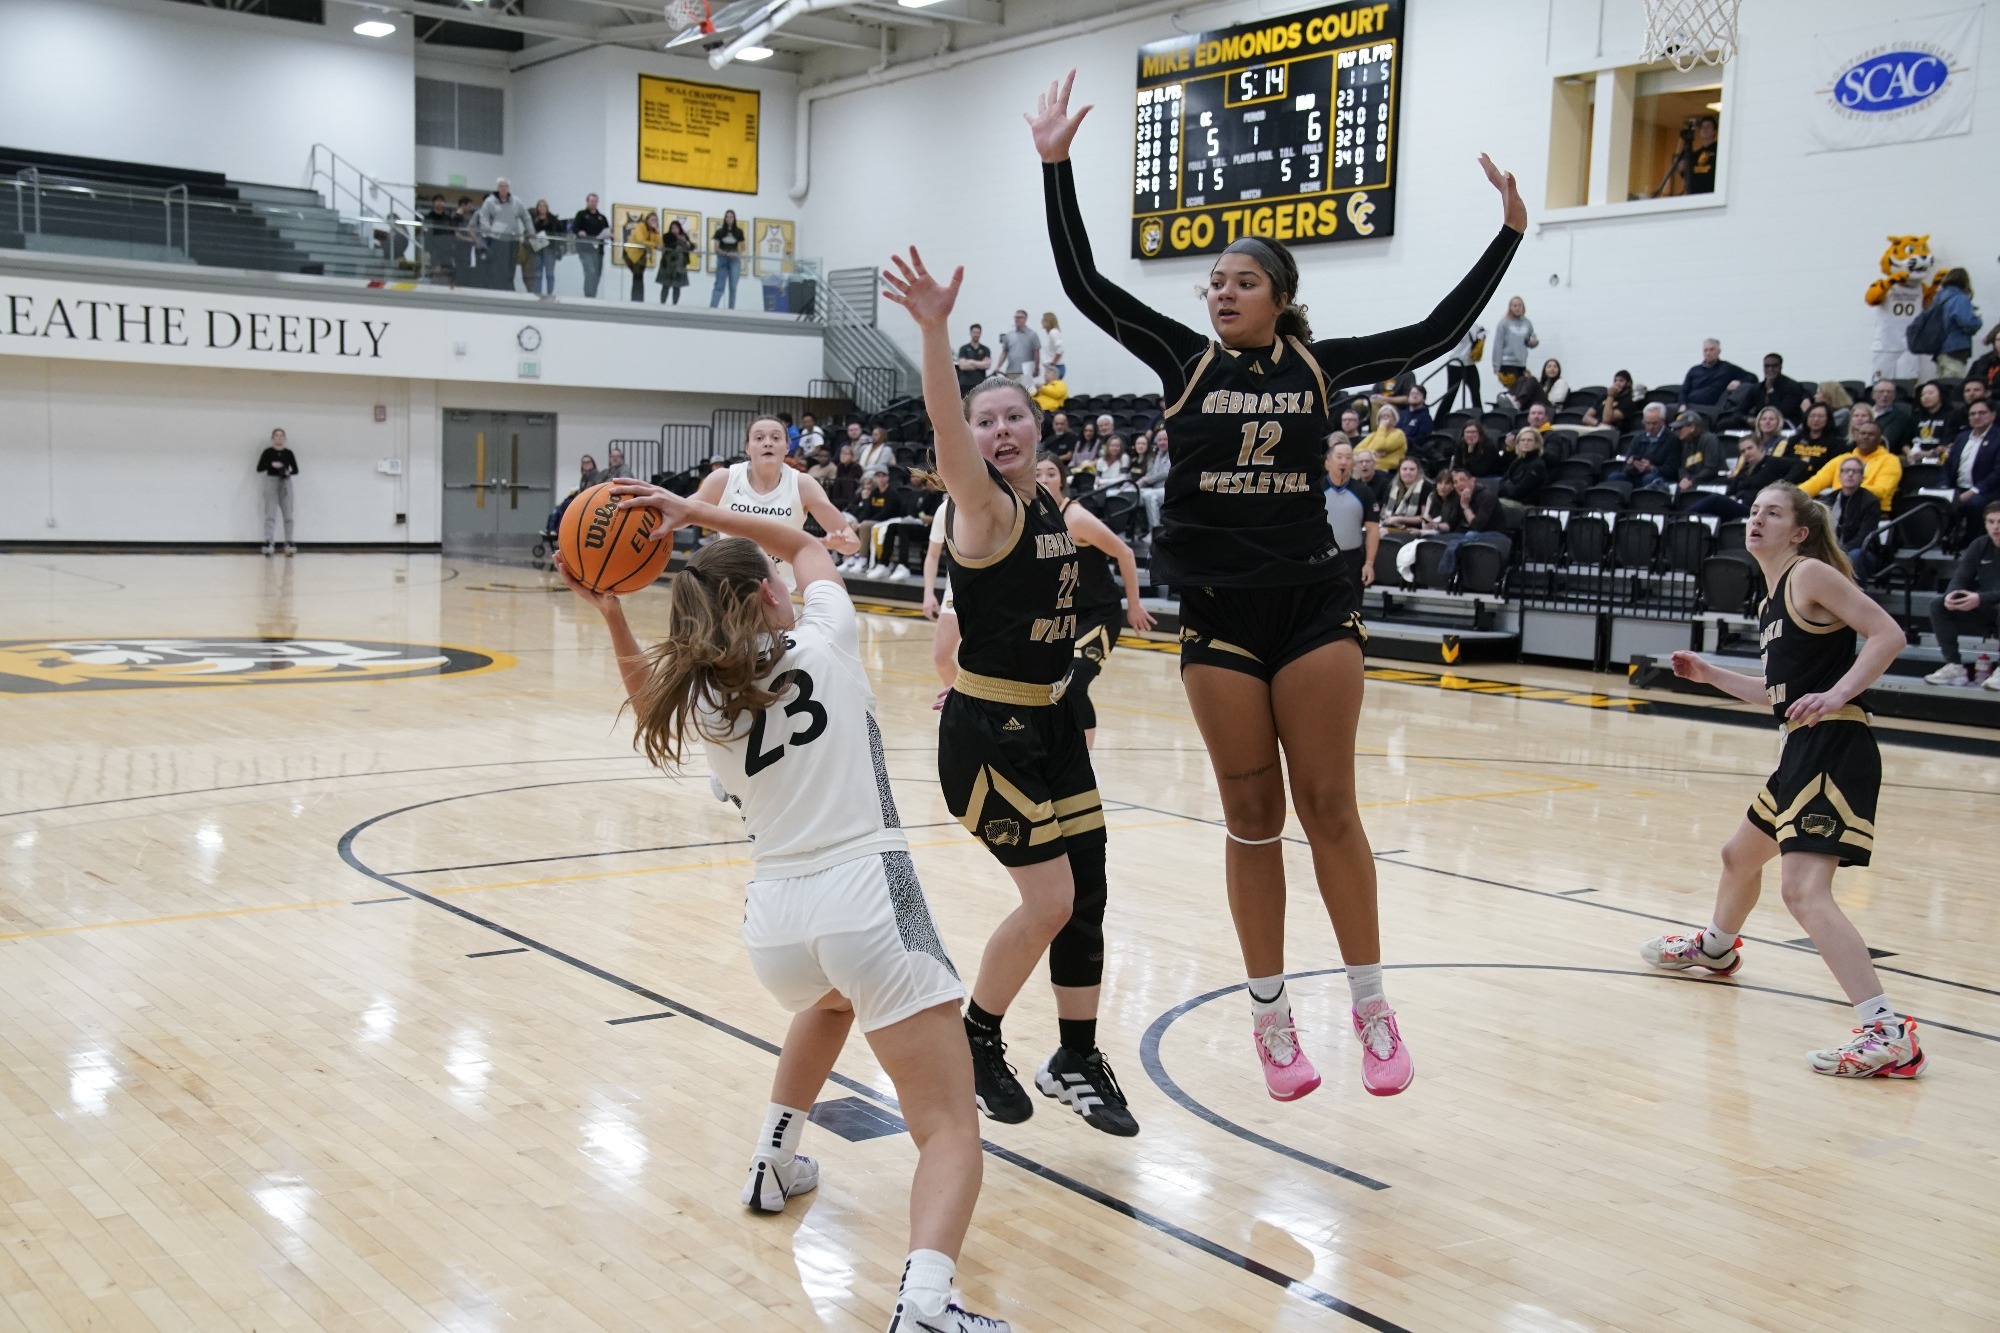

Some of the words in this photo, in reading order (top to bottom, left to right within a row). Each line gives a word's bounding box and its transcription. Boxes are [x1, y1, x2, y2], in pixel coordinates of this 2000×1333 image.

[1142, 51, 1190, 78] MIKE
[1194, 23, 1302, 67] EDMONDS
[1306, 4, 1389, 45] COURT
[1241, 67, 1284, 101] 5:14
[1841, 56, 1937, 106] SCAC
[1337, 88, 1355, 108] 23
[1138, 105, 1152, 123] 22
[1336, 109, 1354, 128] 24
[1137, 123, 1152, 141] 23
[1253, 125, 1259, 145] 1
[1307, 111, 1321, 141] 6
[1207, 127, 1220, 156] 5
[1301, 142, 1323, 156] FOULS
[1336, 128, 1353, 148] 32
[1136, 159, 1151, 177] 32
[1281, 158, 1292, 181] 5
[1308, 154, 1320, 178] 3
[1335, 149, 1352, 168] 34
[1135, 178, 1150, 194] 34
[1169, 173, 1178, 190] 3
[1213, 167, 1224, 191] 5
[1355, 166, 1364, 185] 3
[1300, 181, 1322, 194] SCORE
[1170, 213, 1215, 251] GO
[1221, 199, 1338, 245] TIGERS
[1893, 303, 1915, 316] 00
[0, 295, 189, 347] EATHE
[204, 309, 391, 358] DEEPLY
[1201, 389, 1314, 414] NEBRASKA
[1236, 420, 1283, 467] 12
[584, 493, 623, 550] Wilso
[730, 503, 792, 517] COLORADO
[1055, 561, 1080, 610] 22
[744, 668, 828, 778] 23
